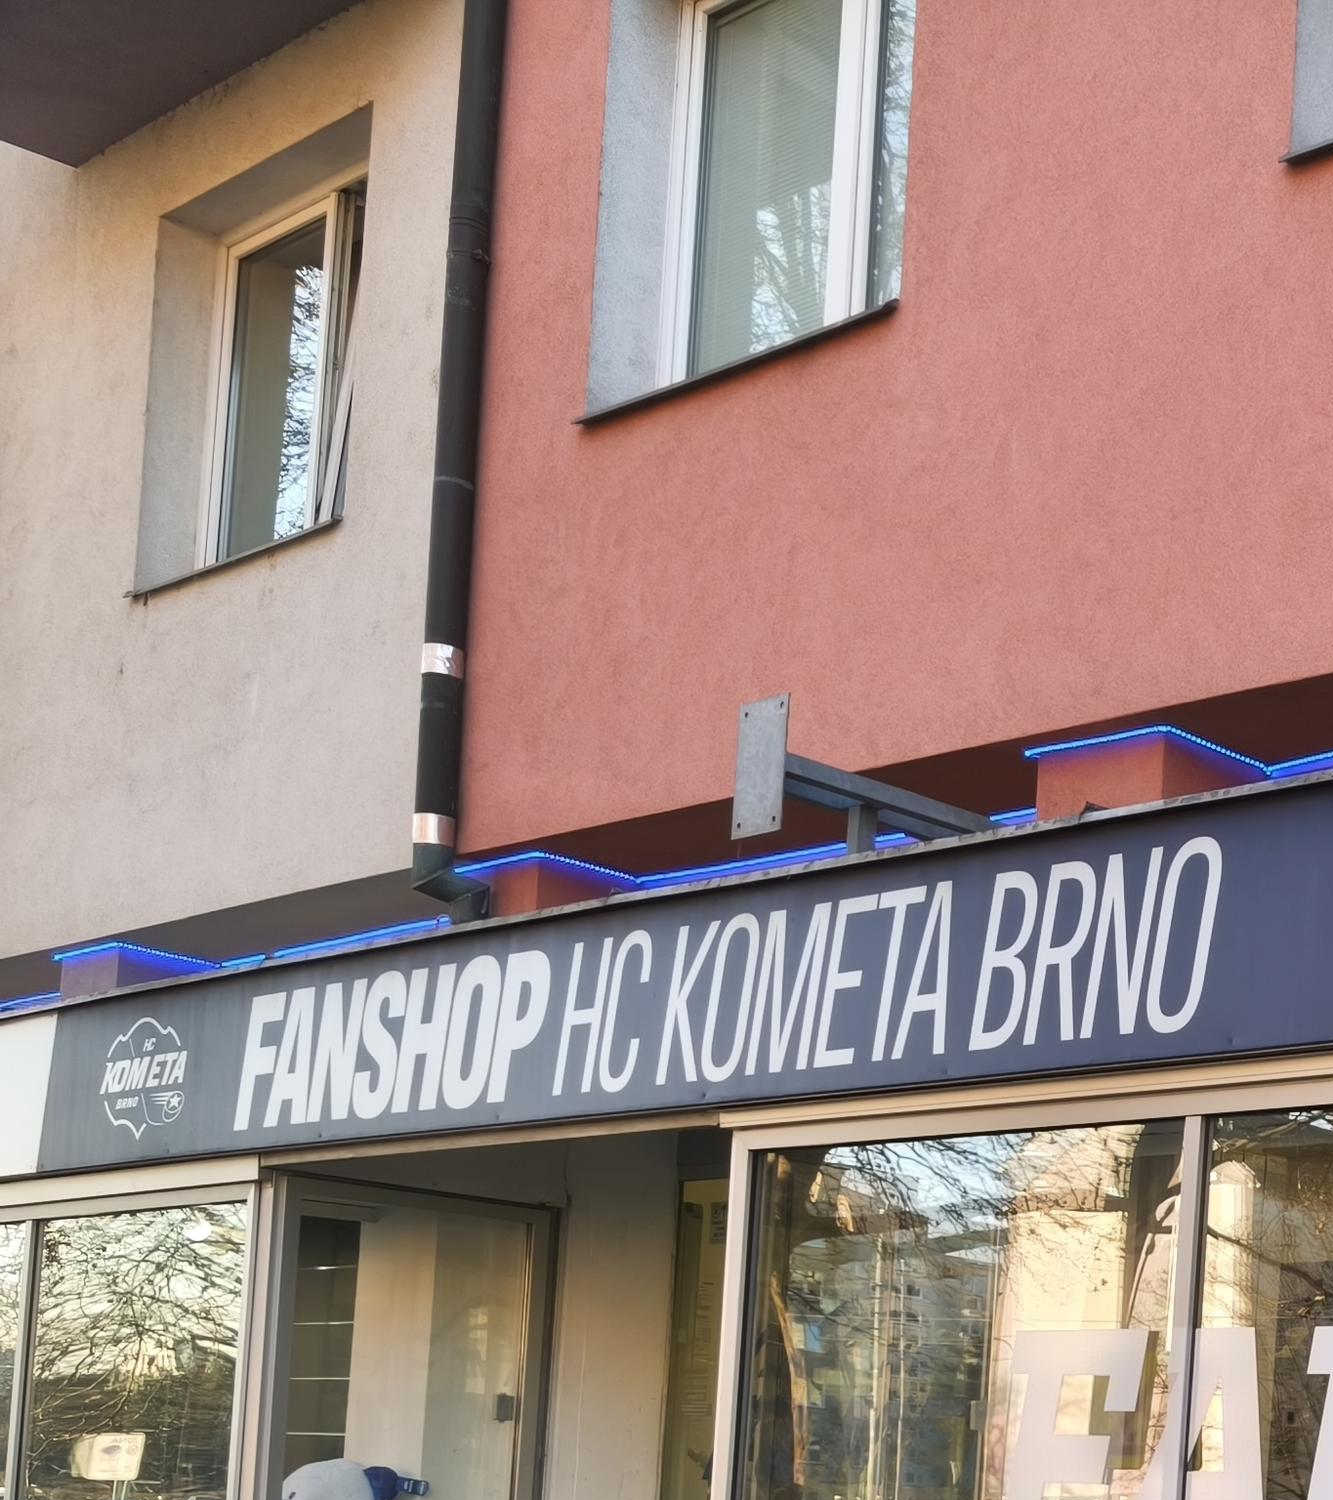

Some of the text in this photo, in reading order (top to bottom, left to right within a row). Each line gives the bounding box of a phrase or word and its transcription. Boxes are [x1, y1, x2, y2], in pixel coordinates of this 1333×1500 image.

[233, 835, 1223, 1131] FANSHOP HC KOMETA BRNO
[142, 1037, 157, 1053] HC
[99, 1050, 188, 1095] KOMETA
[115, 1096, 140, 1110] BRNO
